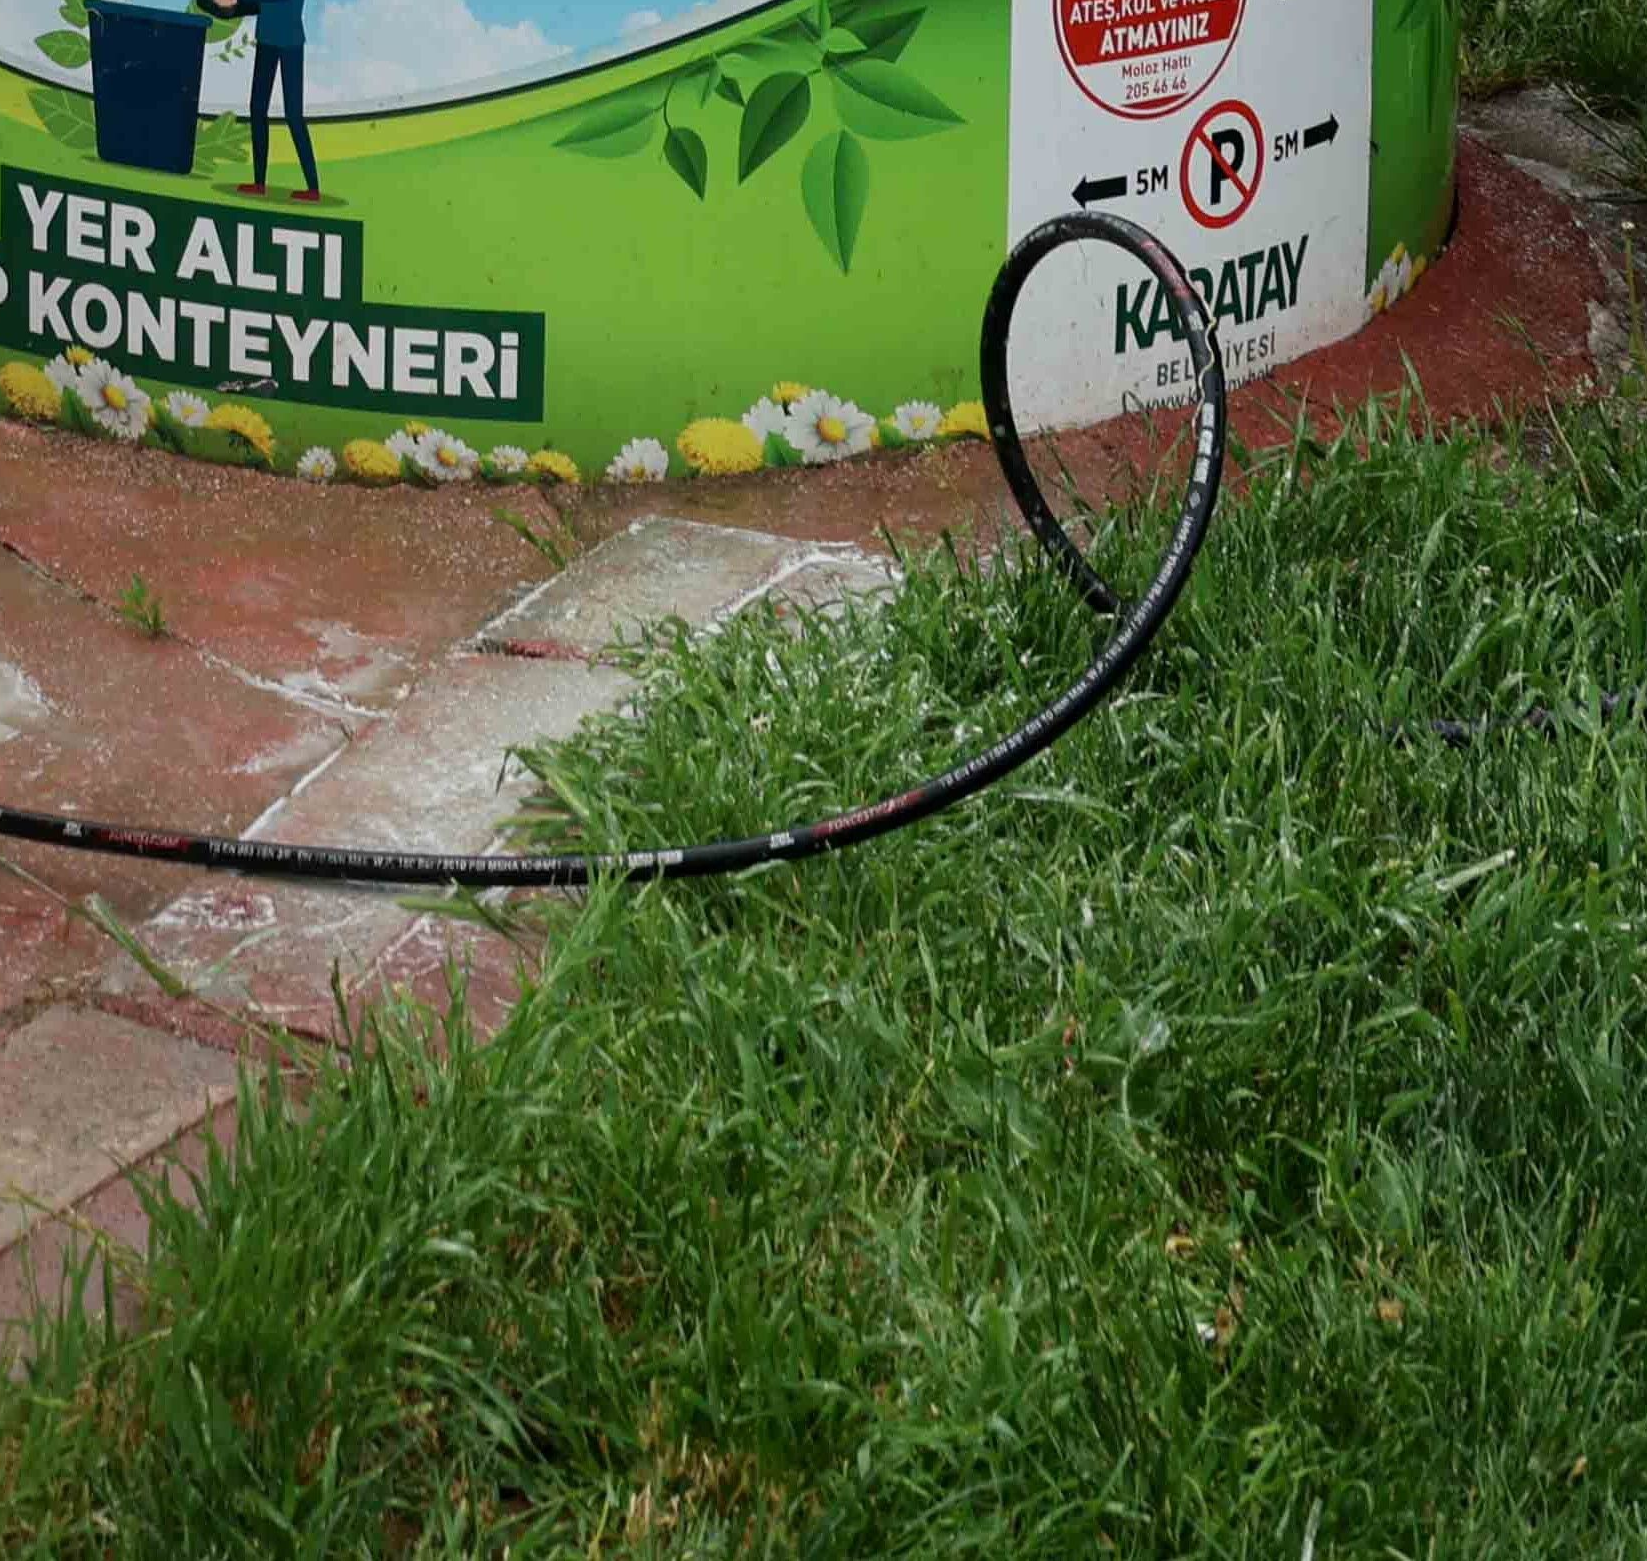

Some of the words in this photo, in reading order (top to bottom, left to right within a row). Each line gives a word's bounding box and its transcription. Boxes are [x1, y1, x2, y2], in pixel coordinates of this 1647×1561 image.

[1099, 12, 1210, 56] ATMAYINIZ
[1121, 59, 1159, 80] Moloz
[1125, 80, 1150, 100] 205
[1152, 78, 1169, 94] 46
[1171, 74, 1187, 91] 46
[1135, 165, 1169, 196] 5M
[1273, 129, 1299, 162] 5M
[17, 183, 156, 275] YER
[176, 216, 343, 301] ALTI
